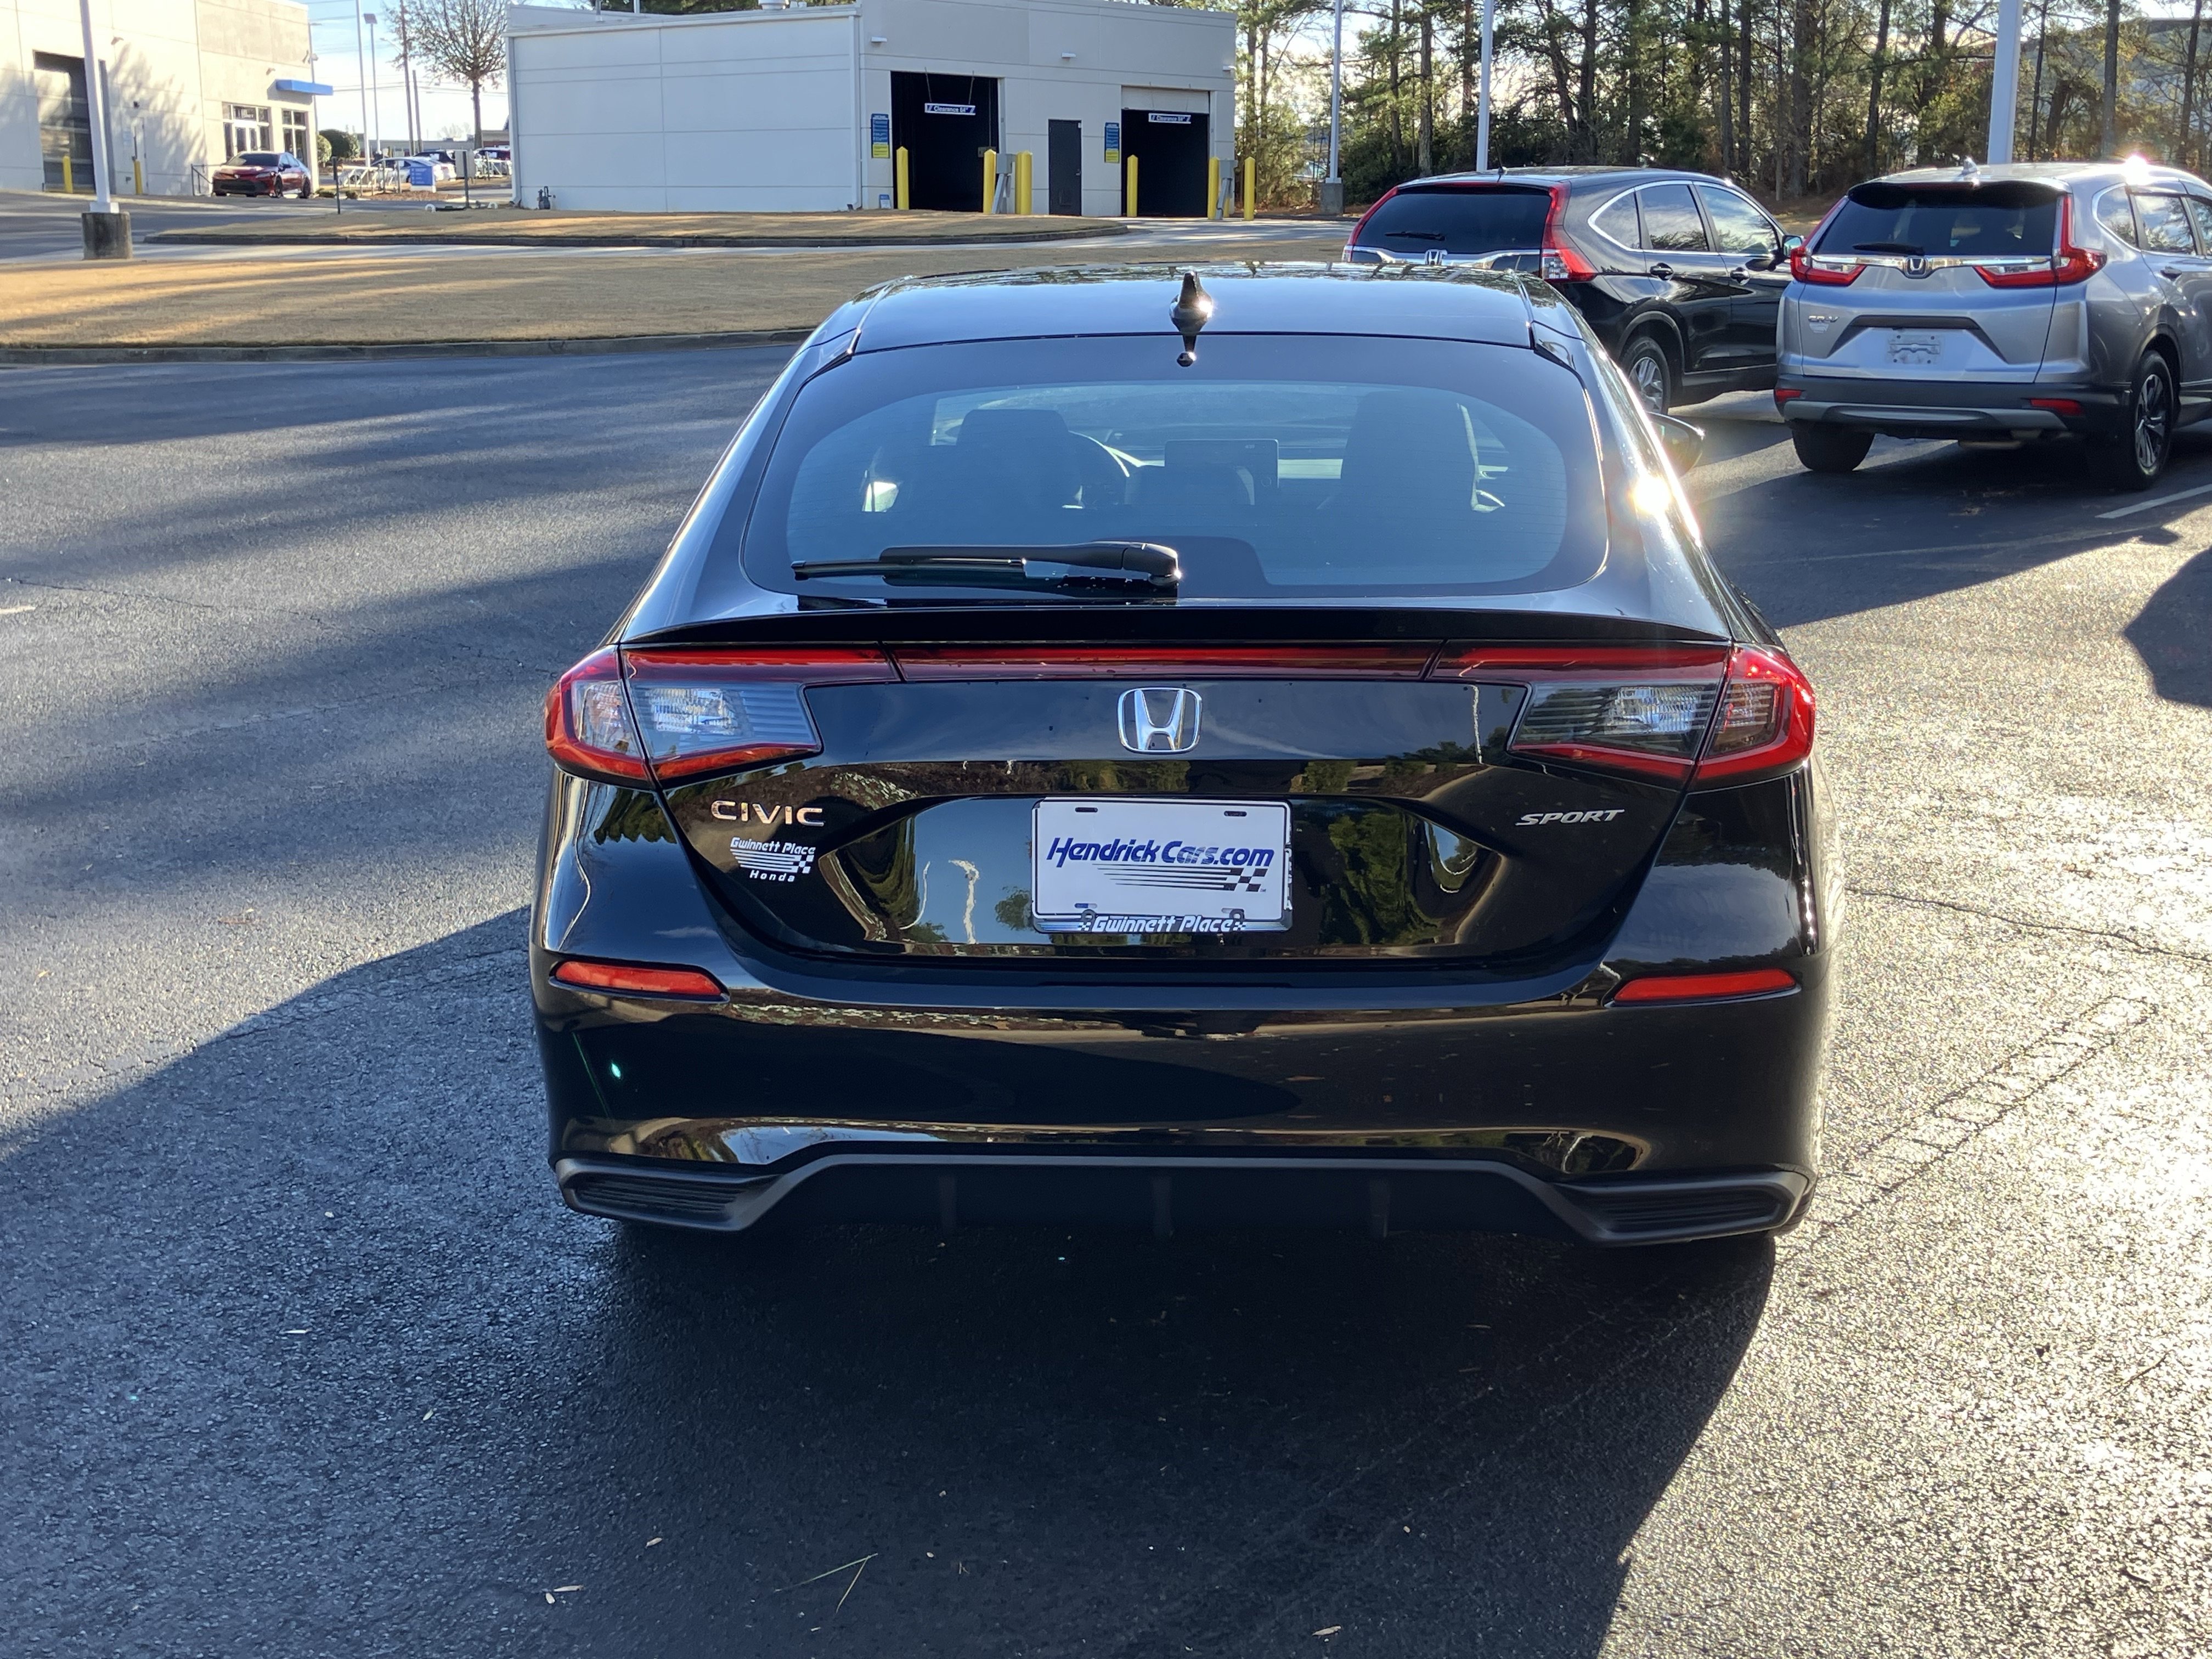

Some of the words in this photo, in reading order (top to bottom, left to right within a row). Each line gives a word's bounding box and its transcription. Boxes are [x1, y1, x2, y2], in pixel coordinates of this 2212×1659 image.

[711, 800, 824, 827] CIVIC
[1515, 809, 1625, 826] SPORT
[730, 837, 780, 853] Gwinnett
[782, 842, 816, 855] Place
[749, 870, 795, 882] Honda
[1092, 915, 1176, 933] Gwinnett
[1179, 916, 1233, 933] Place
